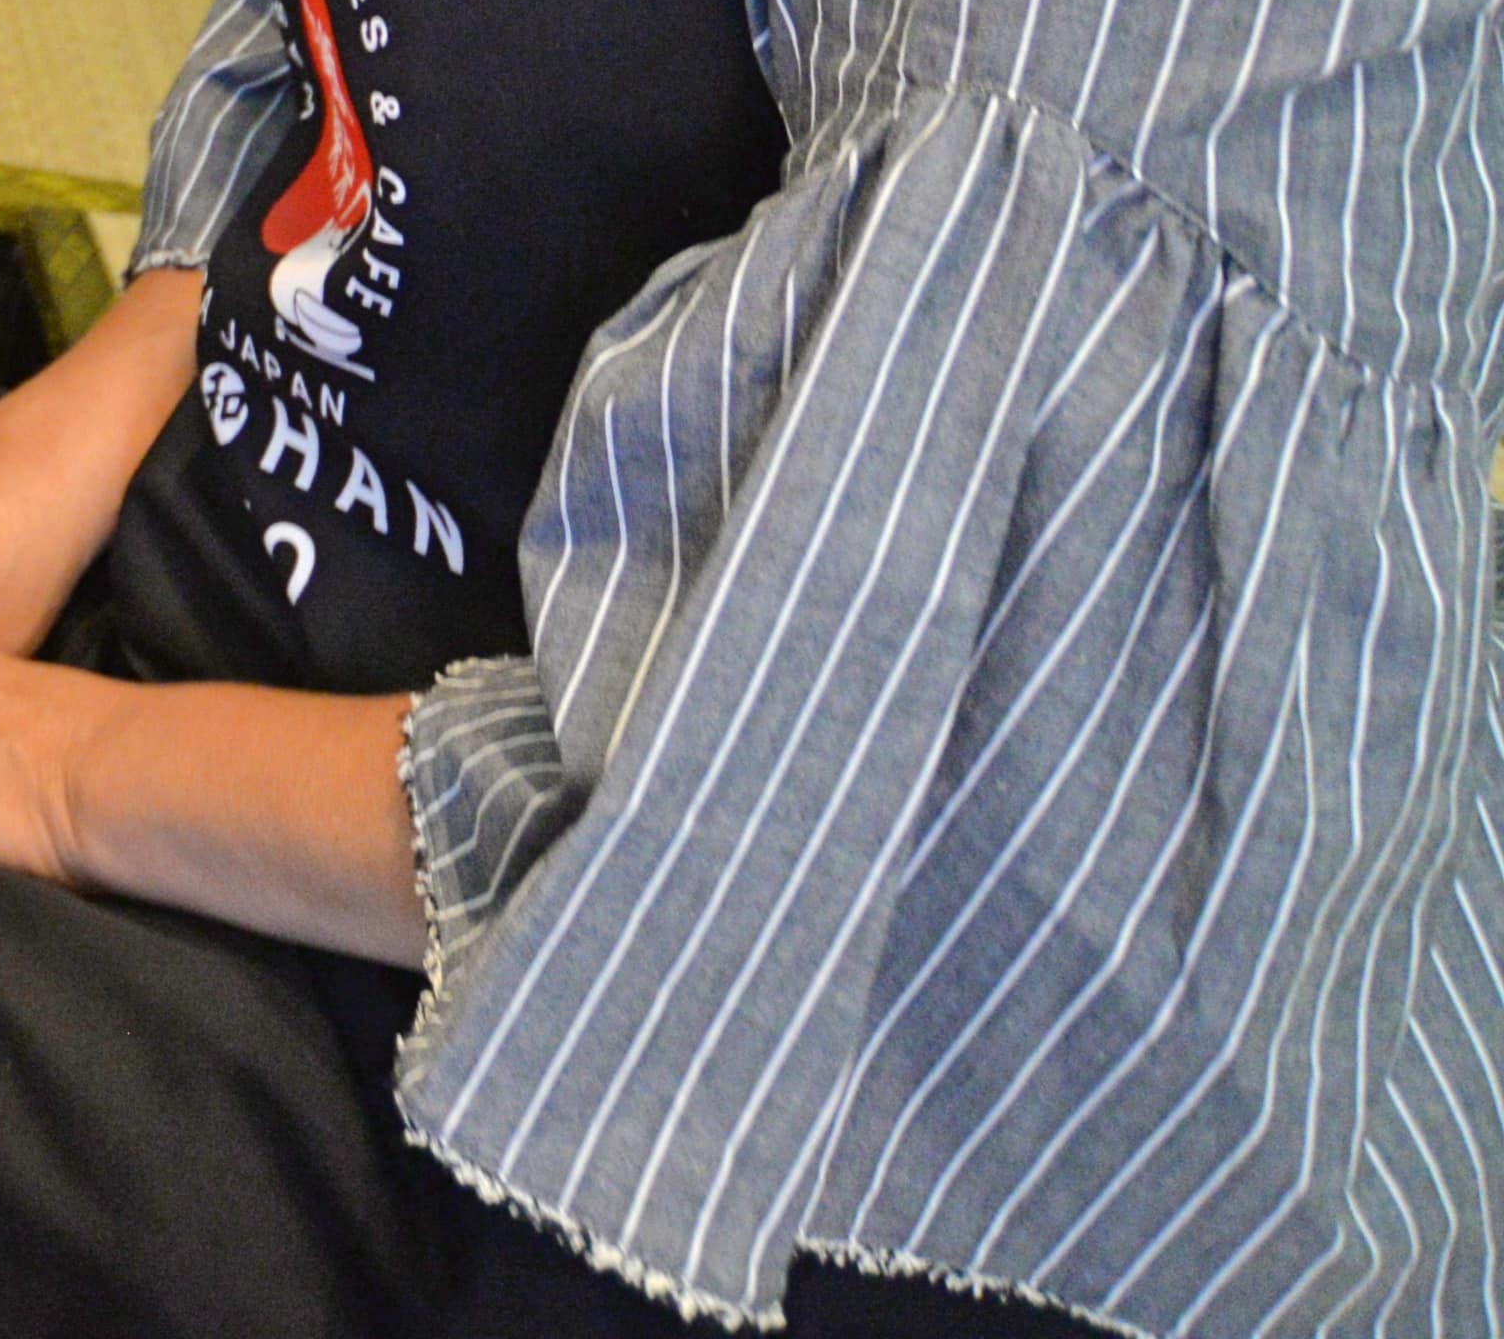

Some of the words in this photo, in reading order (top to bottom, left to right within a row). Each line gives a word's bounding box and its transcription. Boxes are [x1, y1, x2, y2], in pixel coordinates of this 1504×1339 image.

[370, 90, 400, 126] &
[345, 166, 406, 319] CAFE
[220, 318, 345, 427] JAPAN
